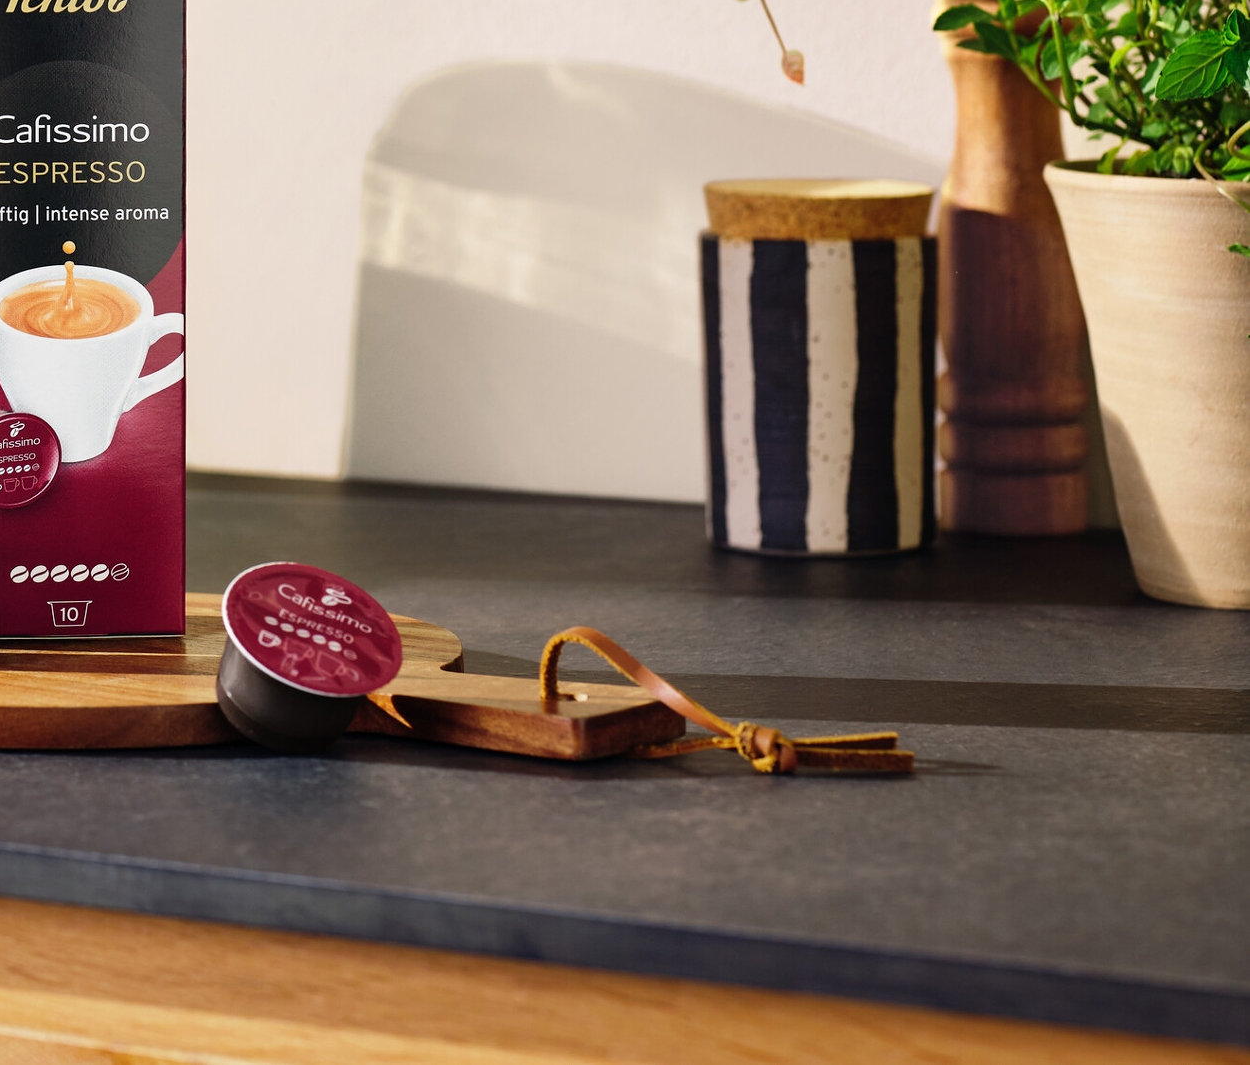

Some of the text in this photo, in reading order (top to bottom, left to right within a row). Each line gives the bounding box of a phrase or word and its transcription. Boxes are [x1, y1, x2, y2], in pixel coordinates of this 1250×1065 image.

[46, 206, 109, 222] intense
[115, 207, 169, 221] aroma
[60, 607, 79, 622] 10
[278, 583, 373, 634] Cafissimo
[279, 608, 355, 644] ESPRESSO
